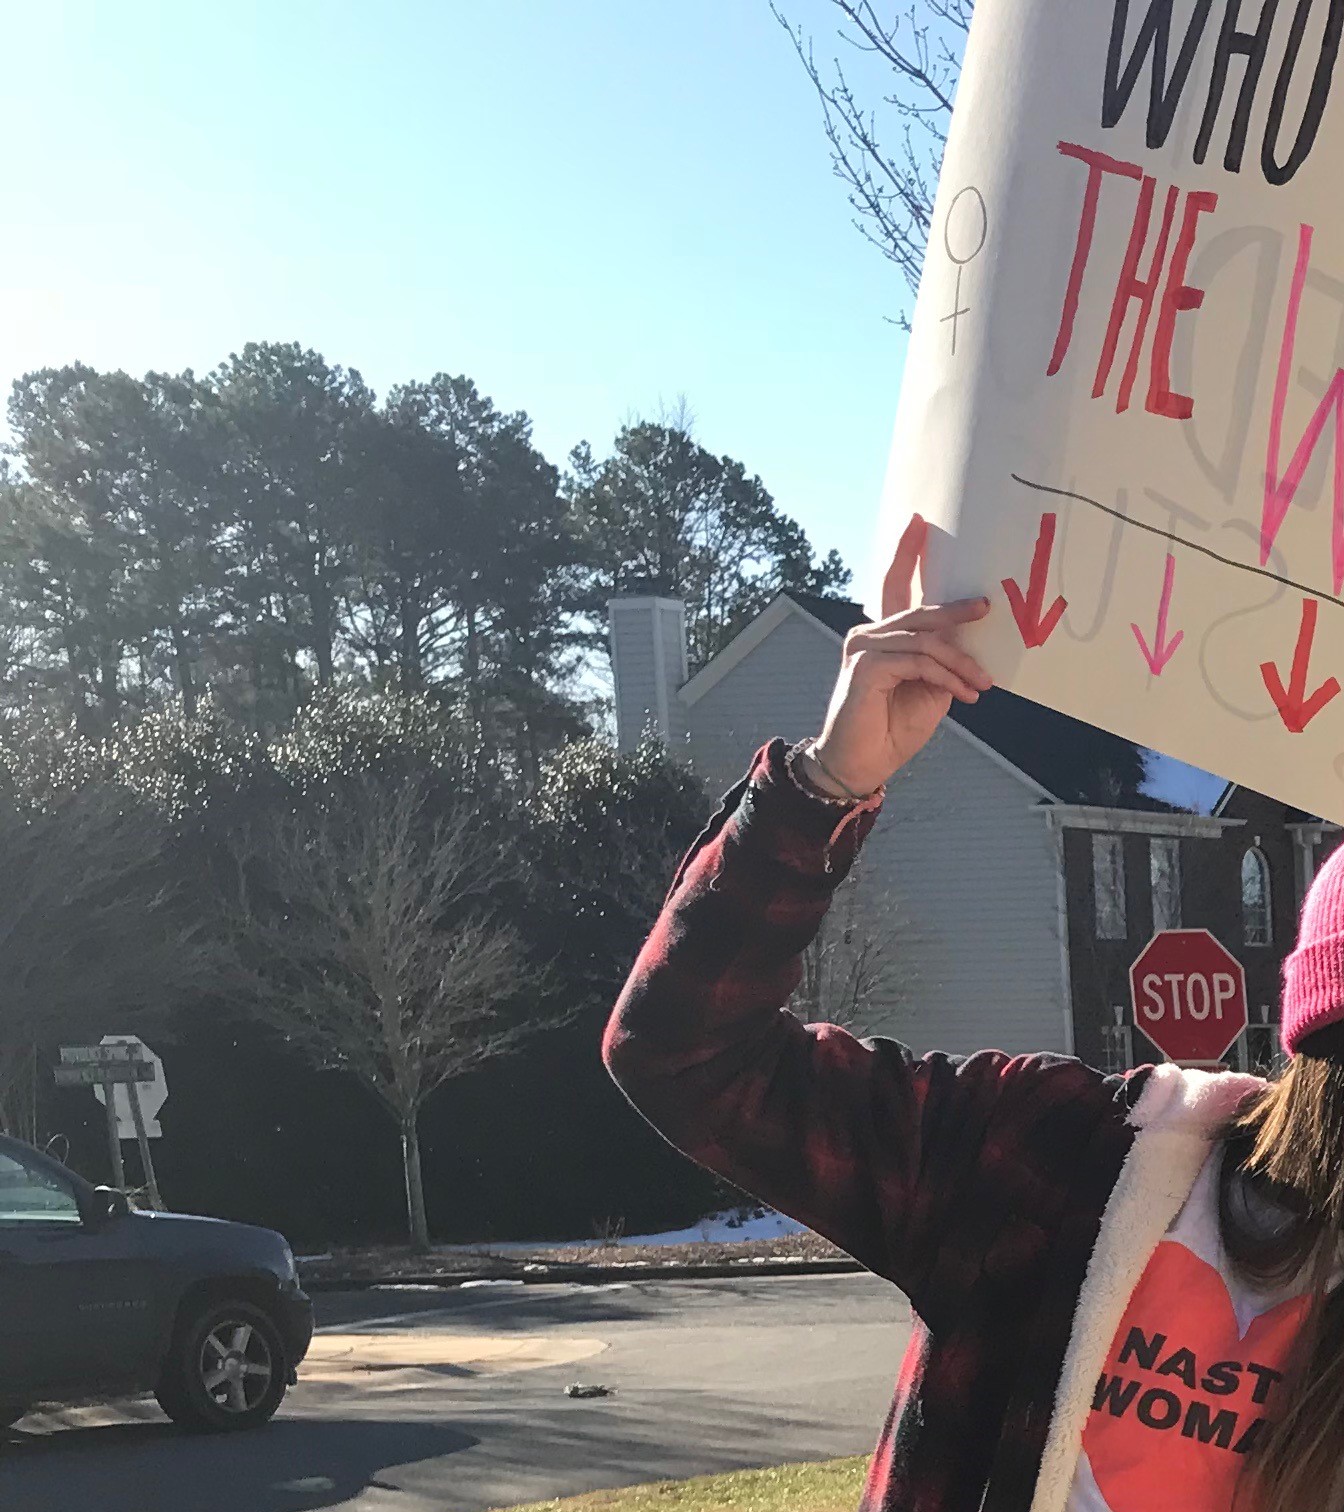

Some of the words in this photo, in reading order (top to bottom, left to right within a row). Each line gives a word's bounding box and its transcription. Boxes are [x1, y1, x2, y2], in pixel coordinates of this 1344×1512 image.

[1102, 0, 1343, 186] WHO
[1046, 141, 1218, 420] THE
[1142, 972, 1236, 1020] STOP
[1118, 1327, 1283, 1404] NAST
[1090, 1371, 1266, 1454] WOM
